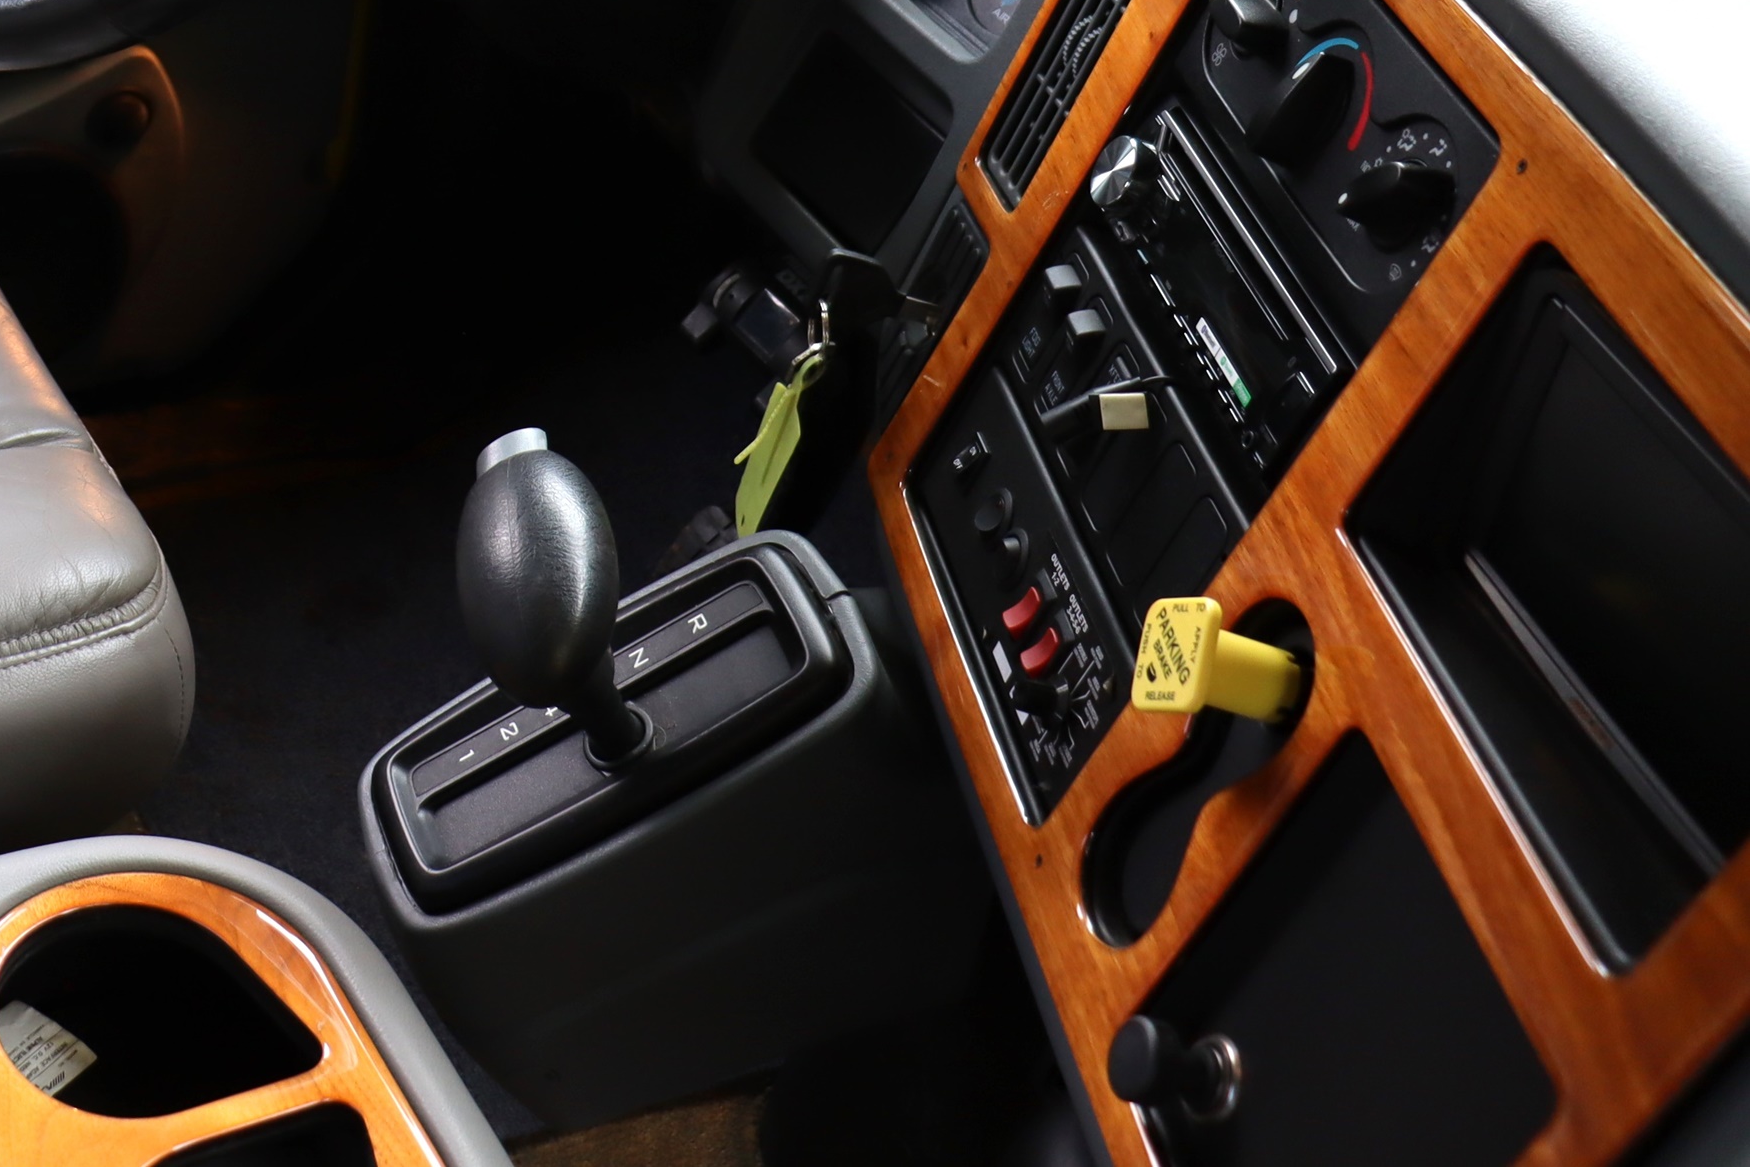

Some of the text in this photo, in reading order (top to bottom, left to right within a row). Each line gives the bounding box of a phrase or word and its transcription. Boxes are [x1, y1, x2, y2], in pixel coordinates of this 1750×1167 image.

[992, 8, 1010, 24] AIR
[1030, 326, 1042, 347] FOG
[1051, 369, 1066, 392] FRONT
[1044, 382, 1058, 406] AXLE
[1050, 552, 1071, 591] OUTLETS
[1069, 593, 1089, 633] OUTLETS
[1172, 602, 1206, 613] PULL TO
[688, 613, 709, 634] R
[1136, 623, 1152, 679] PUSH TO
[1156, 607, 1191, 686] PARKING
[1190, 626, 1202, 663] APPLY
[628, 647, 650, 669] N
[1153, 638, 1173, 681] BRAKE
[1145, 691, 1176, 701] RELEASE
[499, 721, 519, 742] 2
[459, 749, 475, 762] 1
